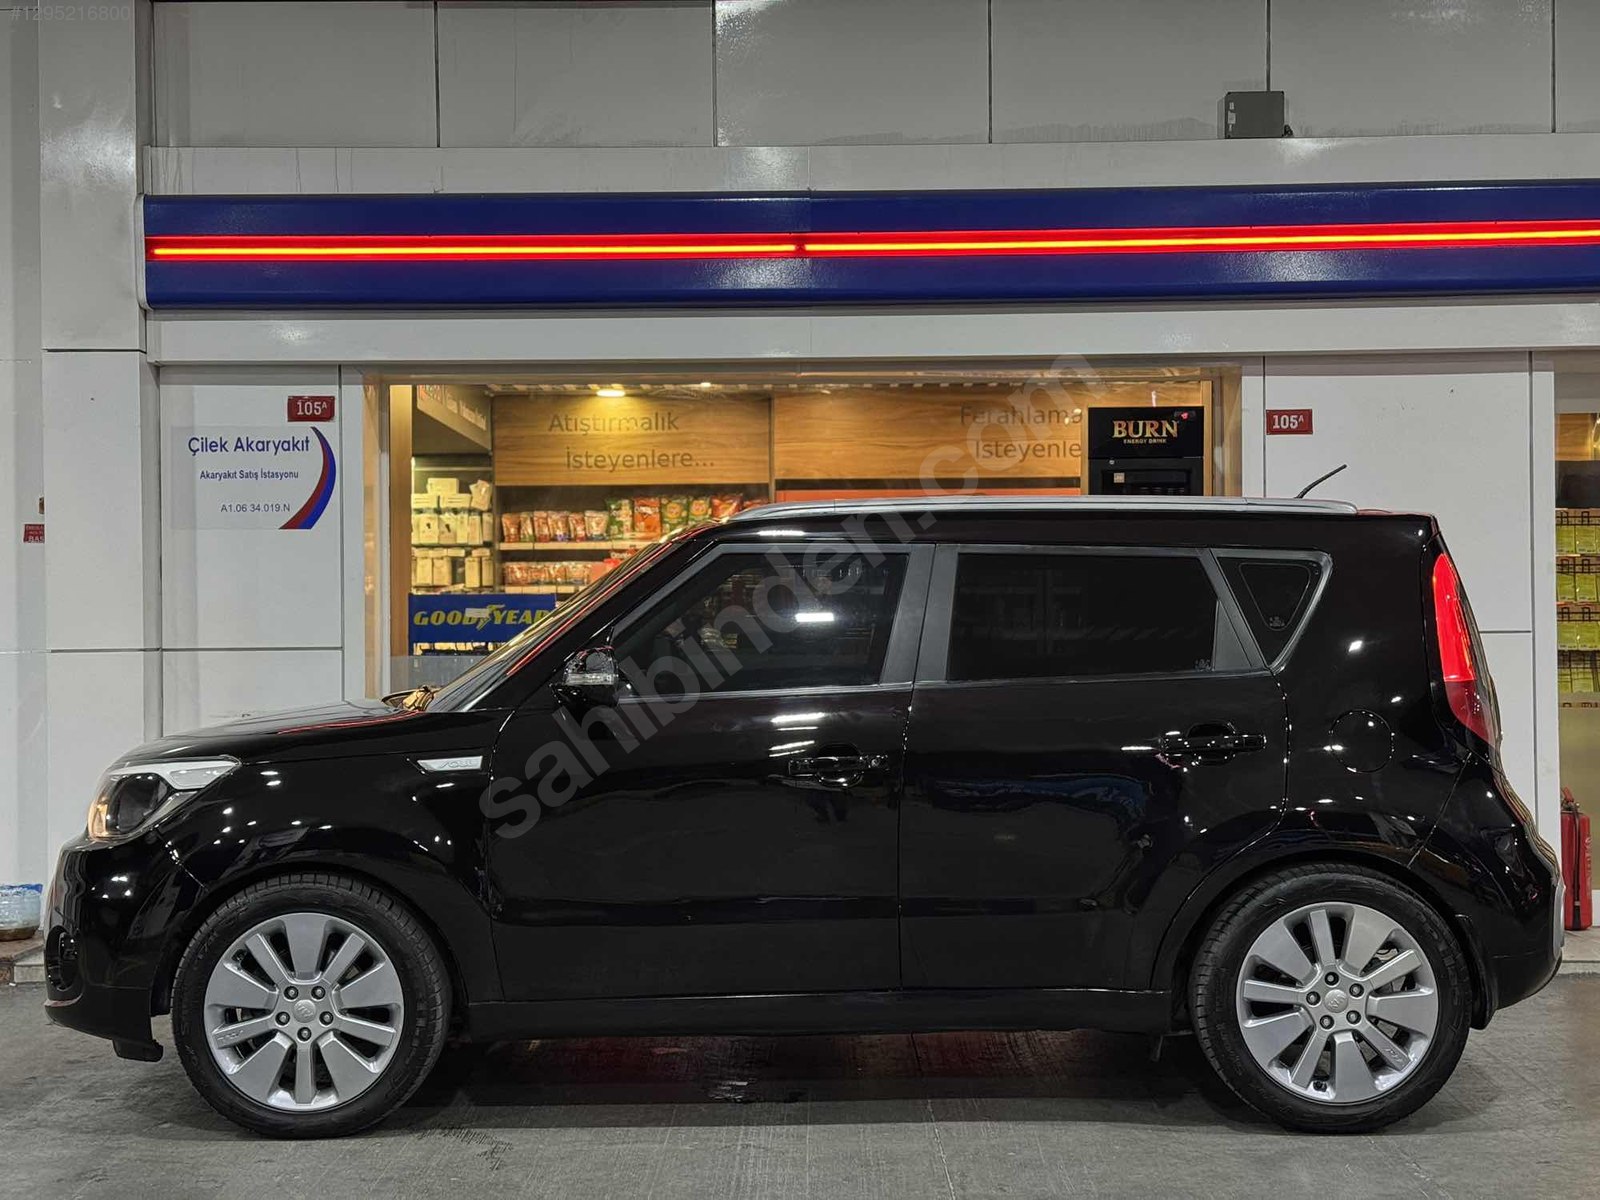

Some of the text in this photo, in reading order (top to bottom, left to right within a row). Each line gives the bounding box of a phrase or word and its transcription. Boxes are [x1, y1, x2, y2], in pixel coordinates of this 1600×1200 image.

[548, 411, 680, 436] Atıştırmalık
[1112, 420, 1178, 439] BURN
[188, 436, 310, 456] Çilek Akaryakıt
[200, 468, 299, 482] Akaryakıt Satış İstasyonu
